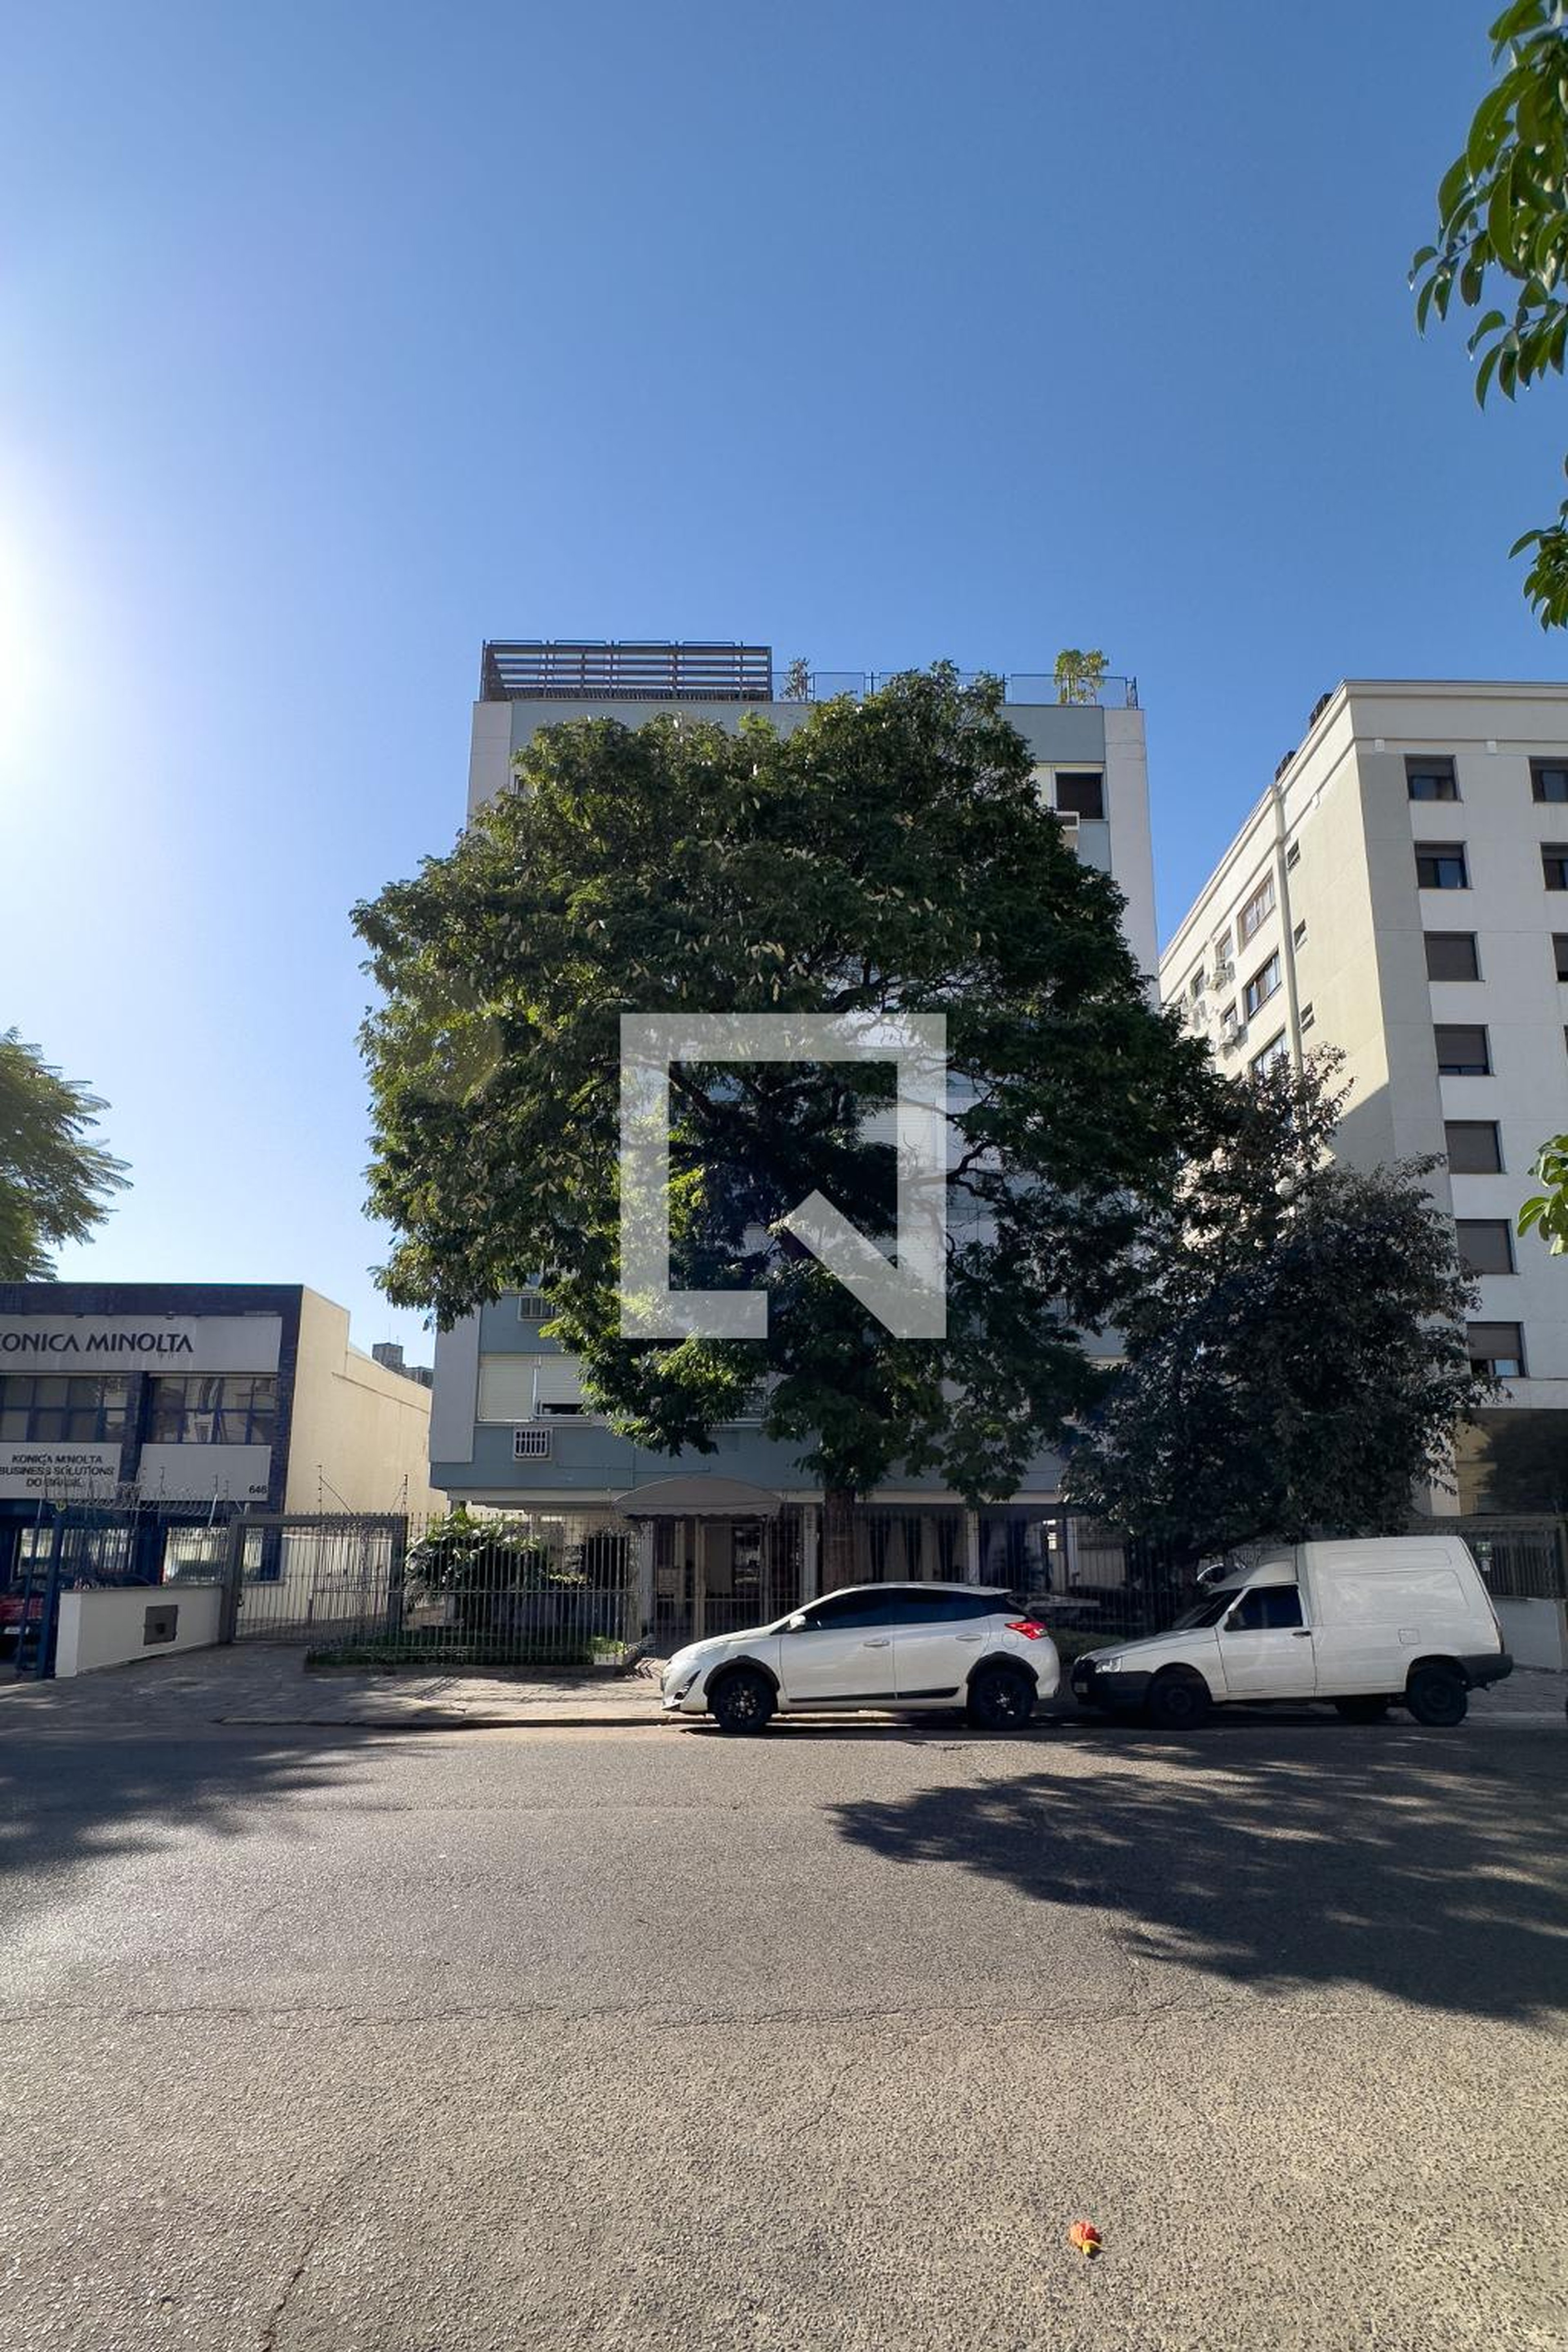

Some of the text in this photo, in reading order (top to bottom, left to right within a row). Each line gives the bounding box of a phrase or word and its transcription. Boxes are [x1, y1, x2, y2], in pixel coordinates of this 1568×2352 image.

[0, 1333, 194, 1352] ONICA MINOLTA
[12, 1454, 102, 1464] KONICA MINOLTA
